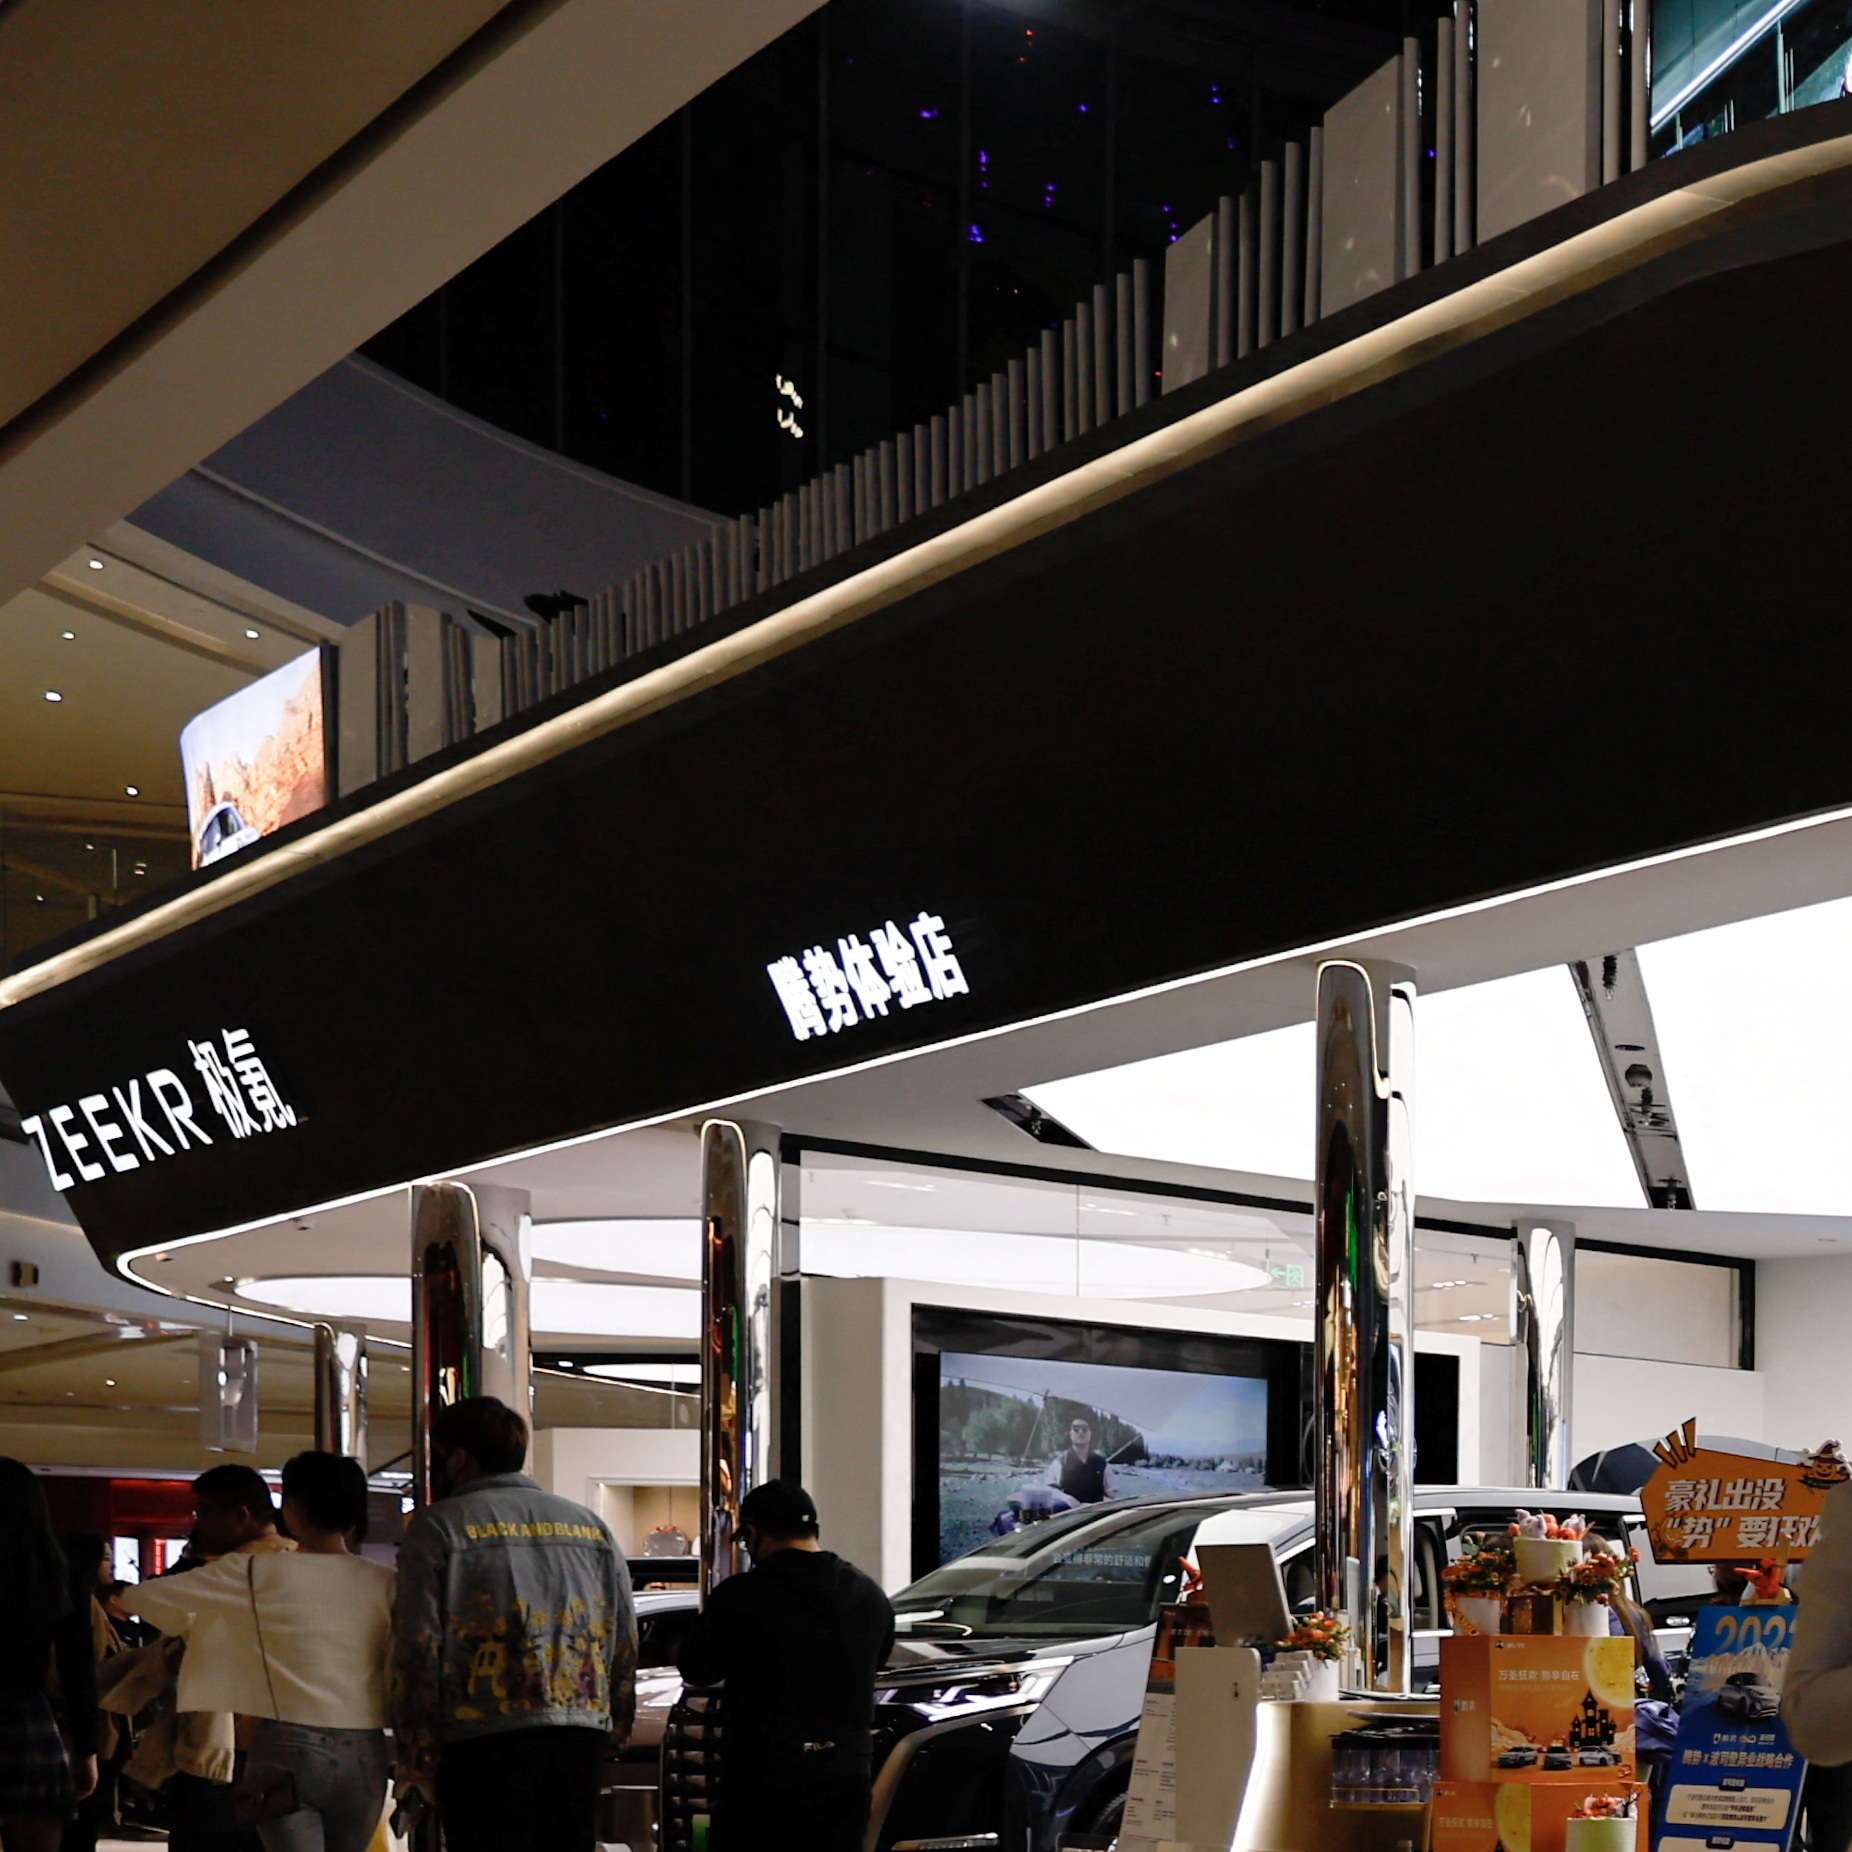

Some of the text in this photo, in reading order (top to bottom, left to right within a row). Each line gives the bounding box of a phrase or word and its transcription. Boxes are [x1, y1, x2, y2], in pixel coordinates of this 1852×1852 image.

[766, 911, 970, 1041] 腾势体验店
[20, 1028, 297, 1192] ZEEKR 极氪
[1664, 1478, 1785, 1511] 豪礼出没
[1715, 1616, 1796, 1652] 202
